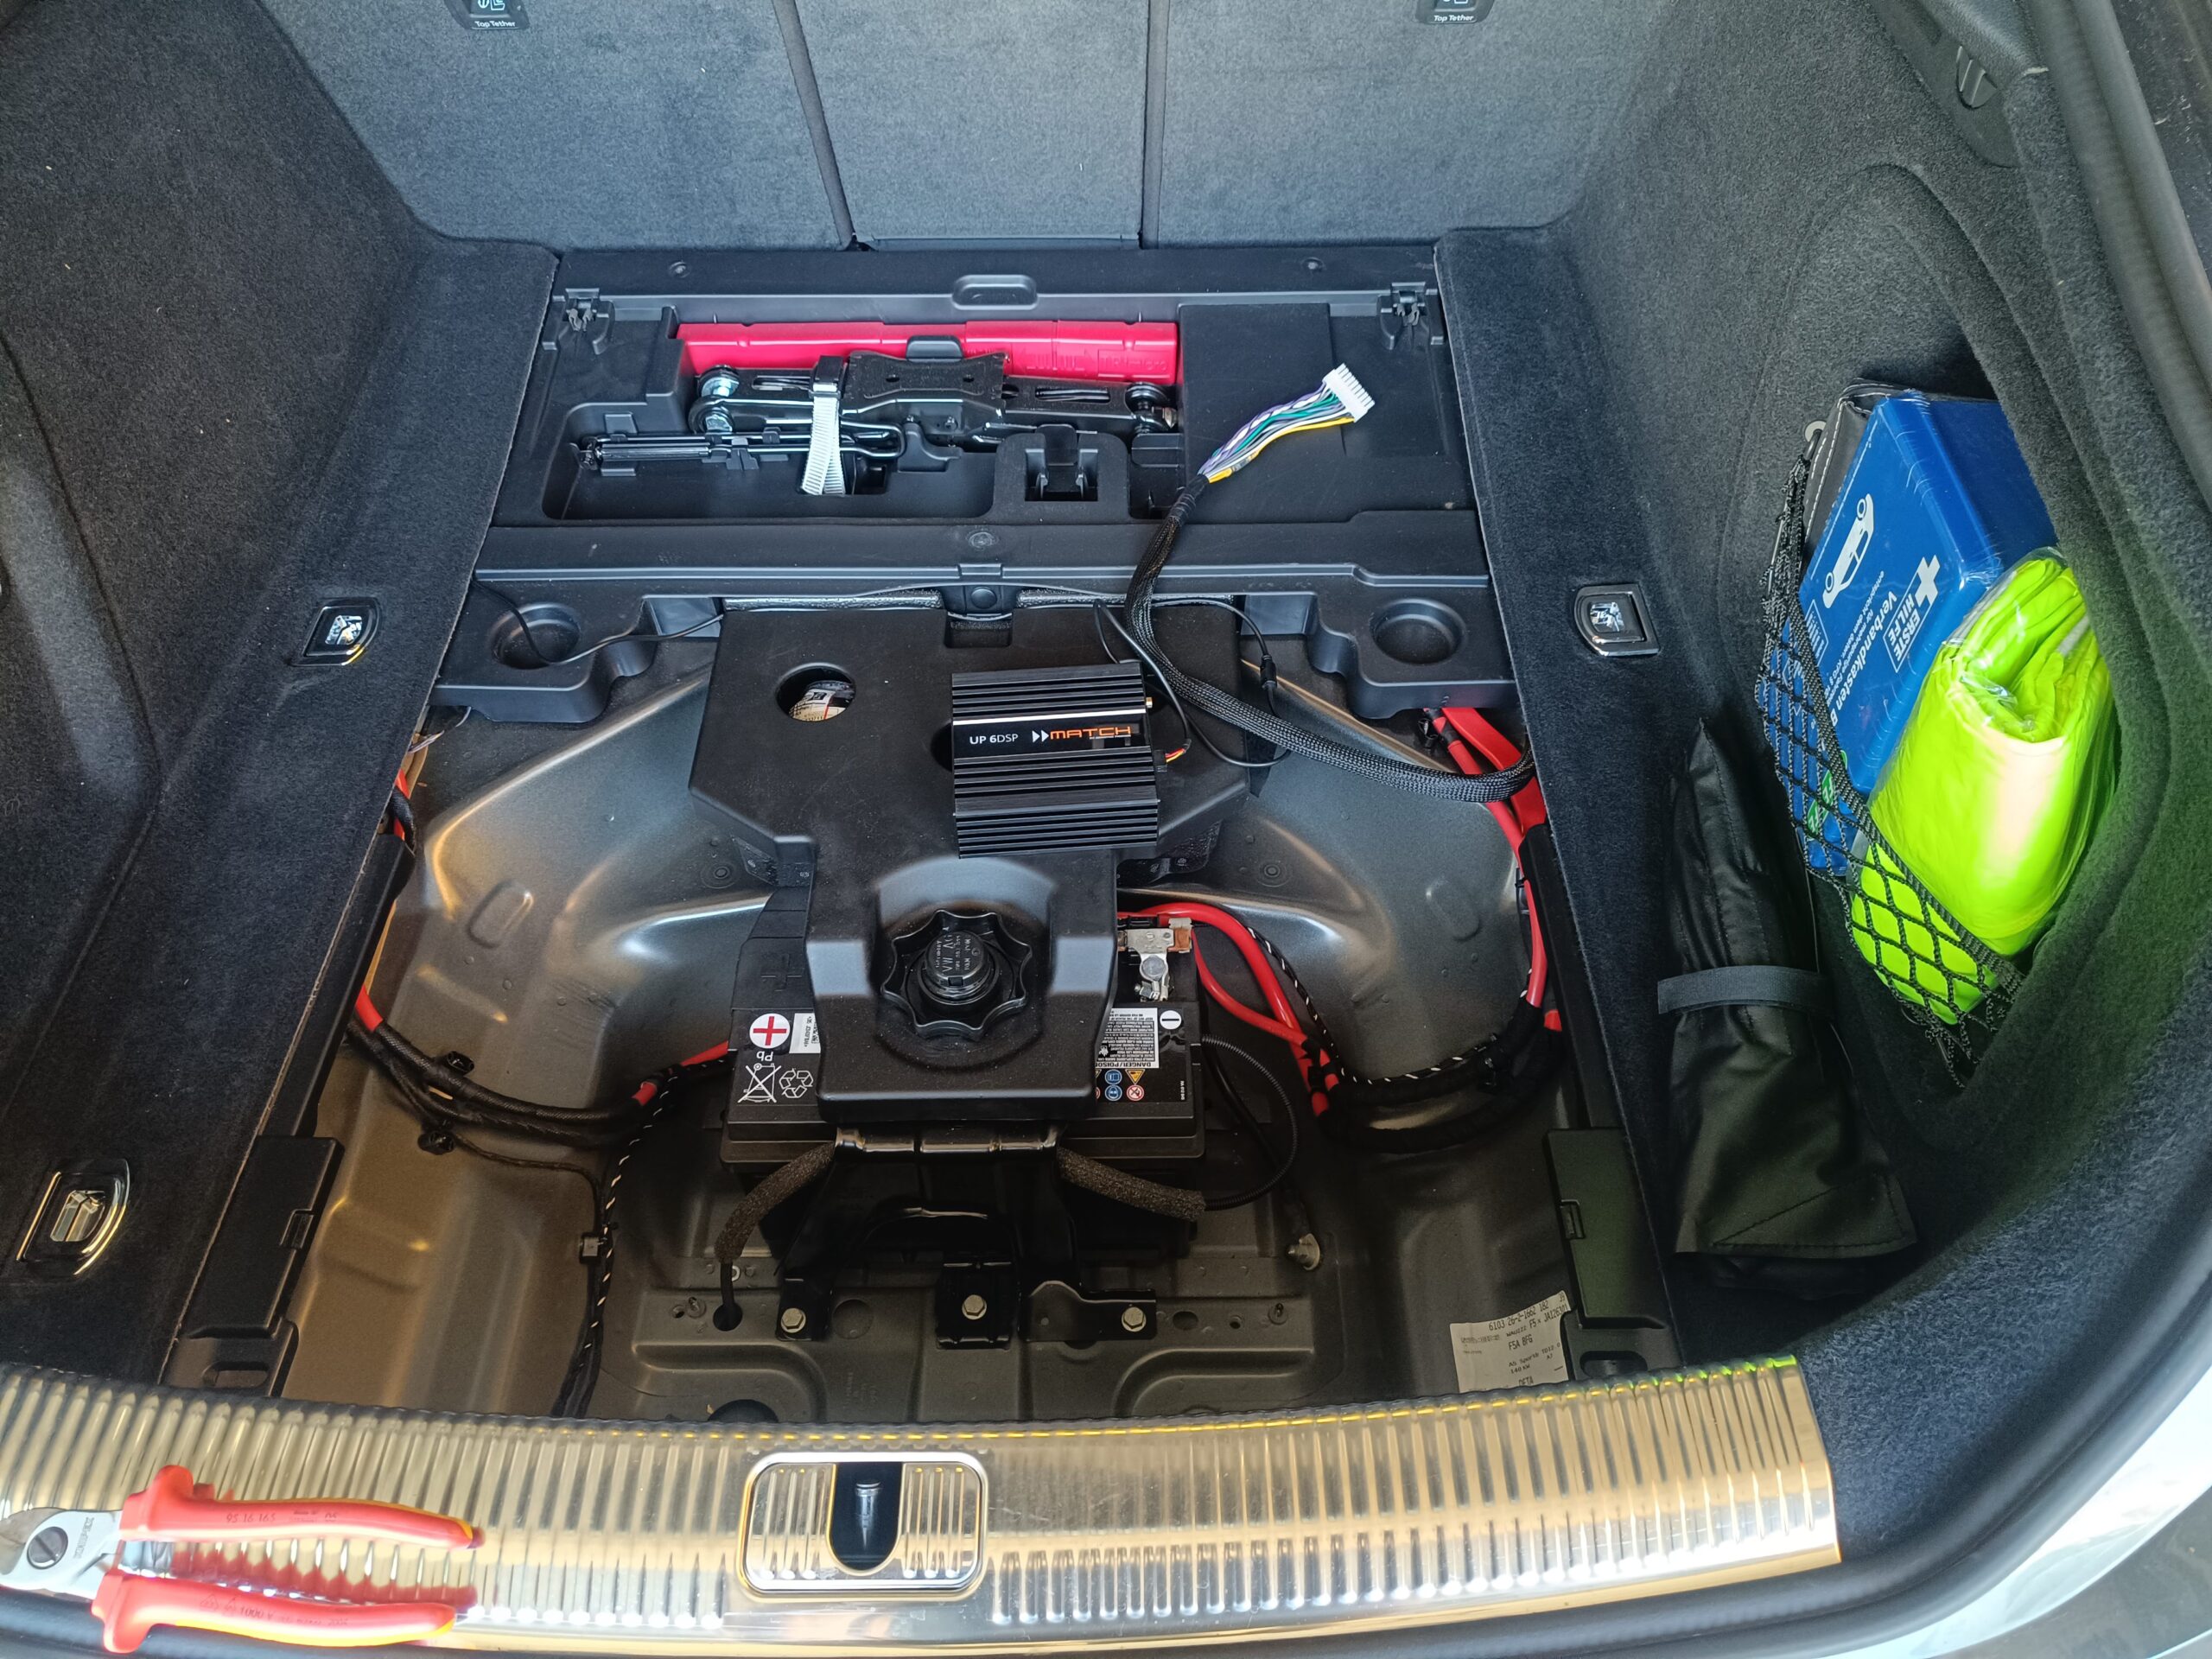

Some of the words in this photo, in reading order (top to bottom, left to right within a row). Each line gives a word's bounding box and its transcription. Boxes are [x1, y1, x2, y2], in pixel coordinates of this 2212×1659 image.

[1434, 15, 1448, 23] Top
[1888, 594, 1915, 645] HILFE
[1894, 608, 1921, 661] ERSTE
[1836, 591, 1897, 710] Verbandkasten
[1830, 708, 1839, 727] B
[969, 735, 987, 745] UP
[989, 734, 1019, 743] 6DSP
[1050, 726, 1132, 741] MATCH
[756, 1051, 774, 1062] Pb
[1489, 1319, 1505, 1331] 6103
[1529, 1318, 1537, 1329] F5
[1509, 1340, 1521, 1350] F5A
[226, 1514, 238, 1523] 95
[242, 1513, 254, 1523] 16
[240, 1606, 264, 1618] 1000
